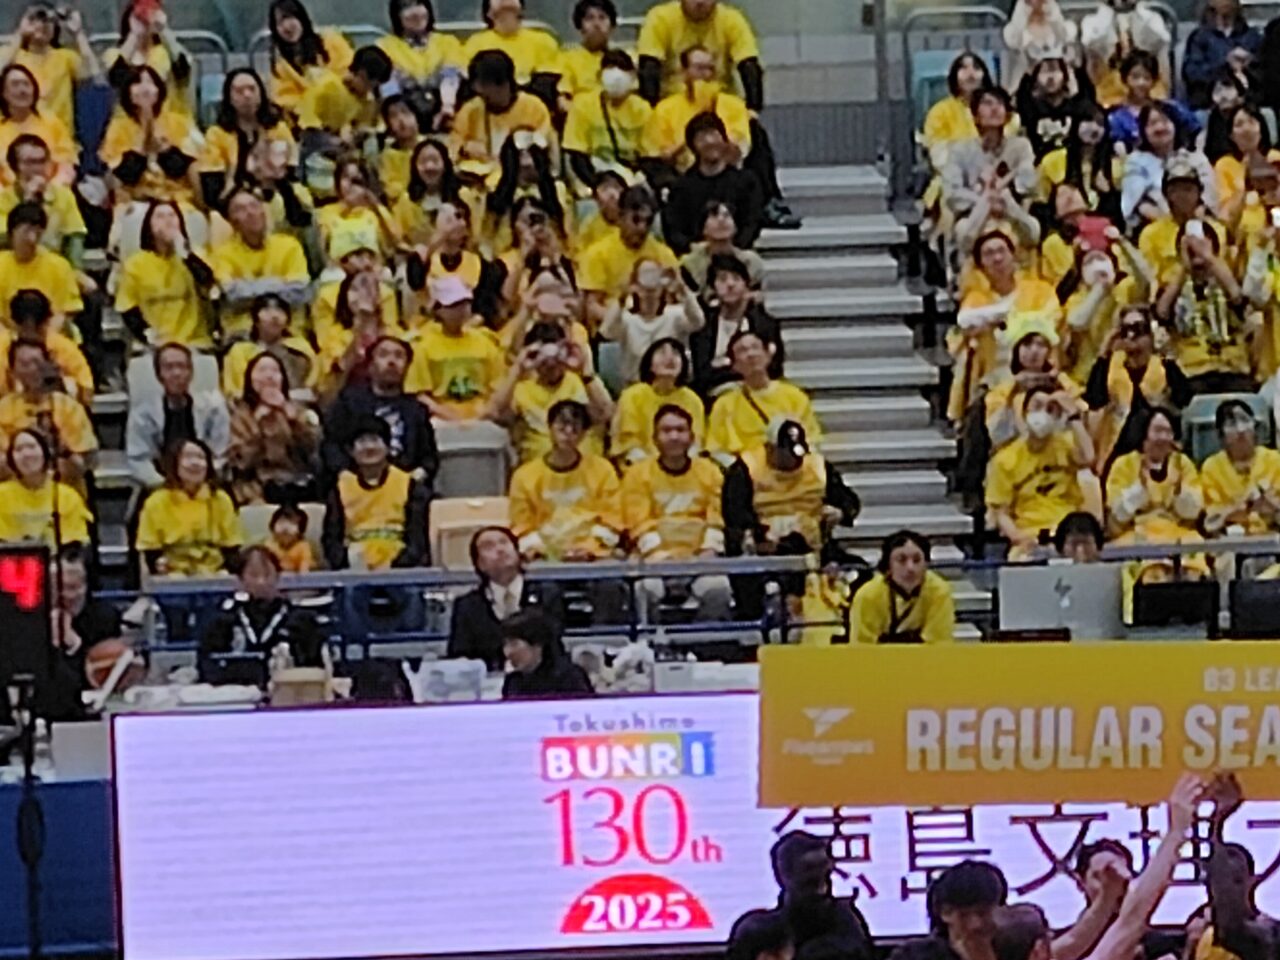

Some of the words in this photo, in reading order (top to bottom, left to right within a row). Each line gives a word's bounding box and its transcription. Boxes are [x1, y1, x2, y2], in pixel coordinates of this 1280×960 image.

[0, 555, 42, 609] 4
[546, 741, 706, 779] BUNRI
[905, 705, 1163, 772] REGULAR
[543, 784, 723, 867] 130th
[580, 892, 692, 932] 2025
